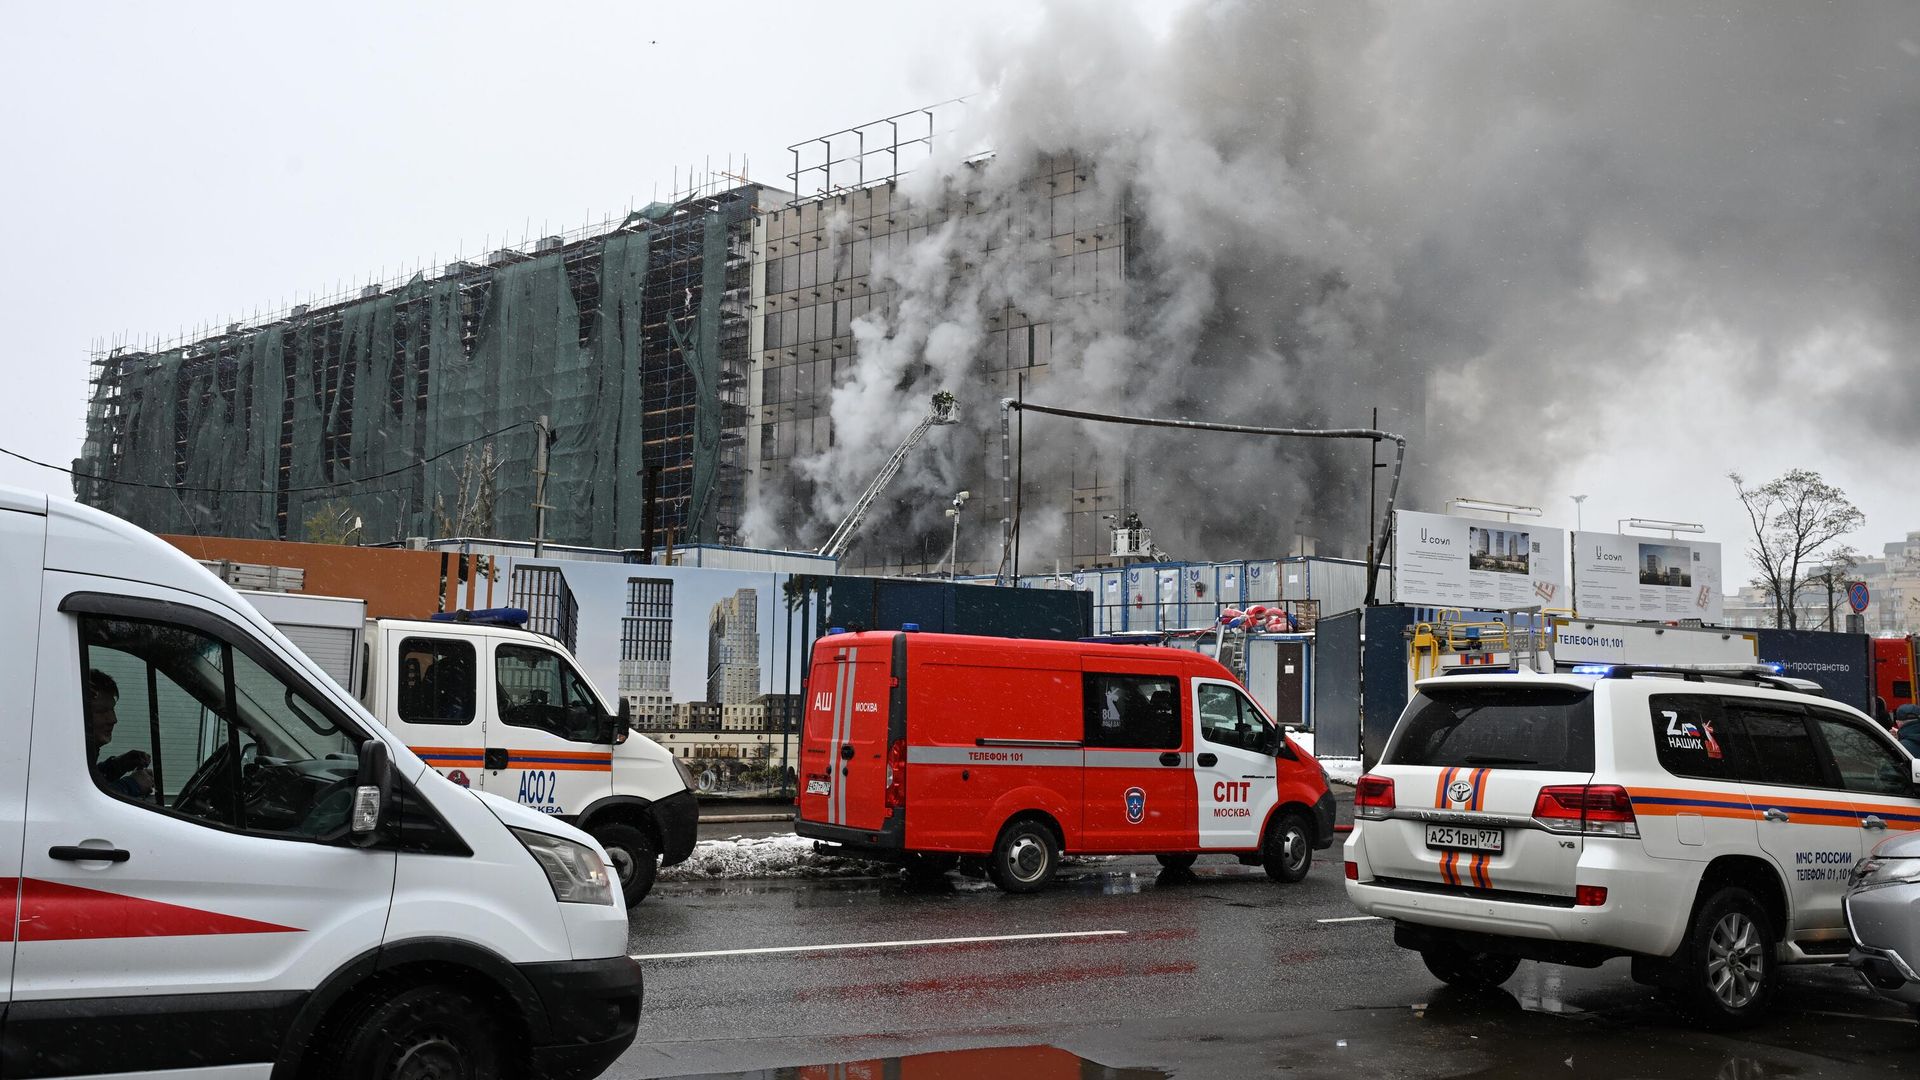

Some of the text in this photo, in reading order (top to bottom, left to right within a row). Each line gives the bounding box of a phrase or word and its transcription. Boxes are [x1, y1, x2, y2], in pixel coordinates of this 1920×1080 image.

[1559, 634, 1624, 648] ТЕЛЕФОН 01,101
[814, 692, 833, 711] АШ
[855, 702, 878, 713] МОСКВА
[1667, 736, 1704, 750] НАШИХ
[968, 752, 1024, 761] ТЕЛЕФОН 101
[517, 770, 556, 804] АСО 2
[1213, 781, 1251, 803] СПТ
[1213, 808, 1251, 818] МОСКВА
[1558, 840, 1576, 849] V8
[1796, 852, 1852, 864] МЧС РОССИИ
[1797, 868, 1826, 881] ТЕЛЕФОН
